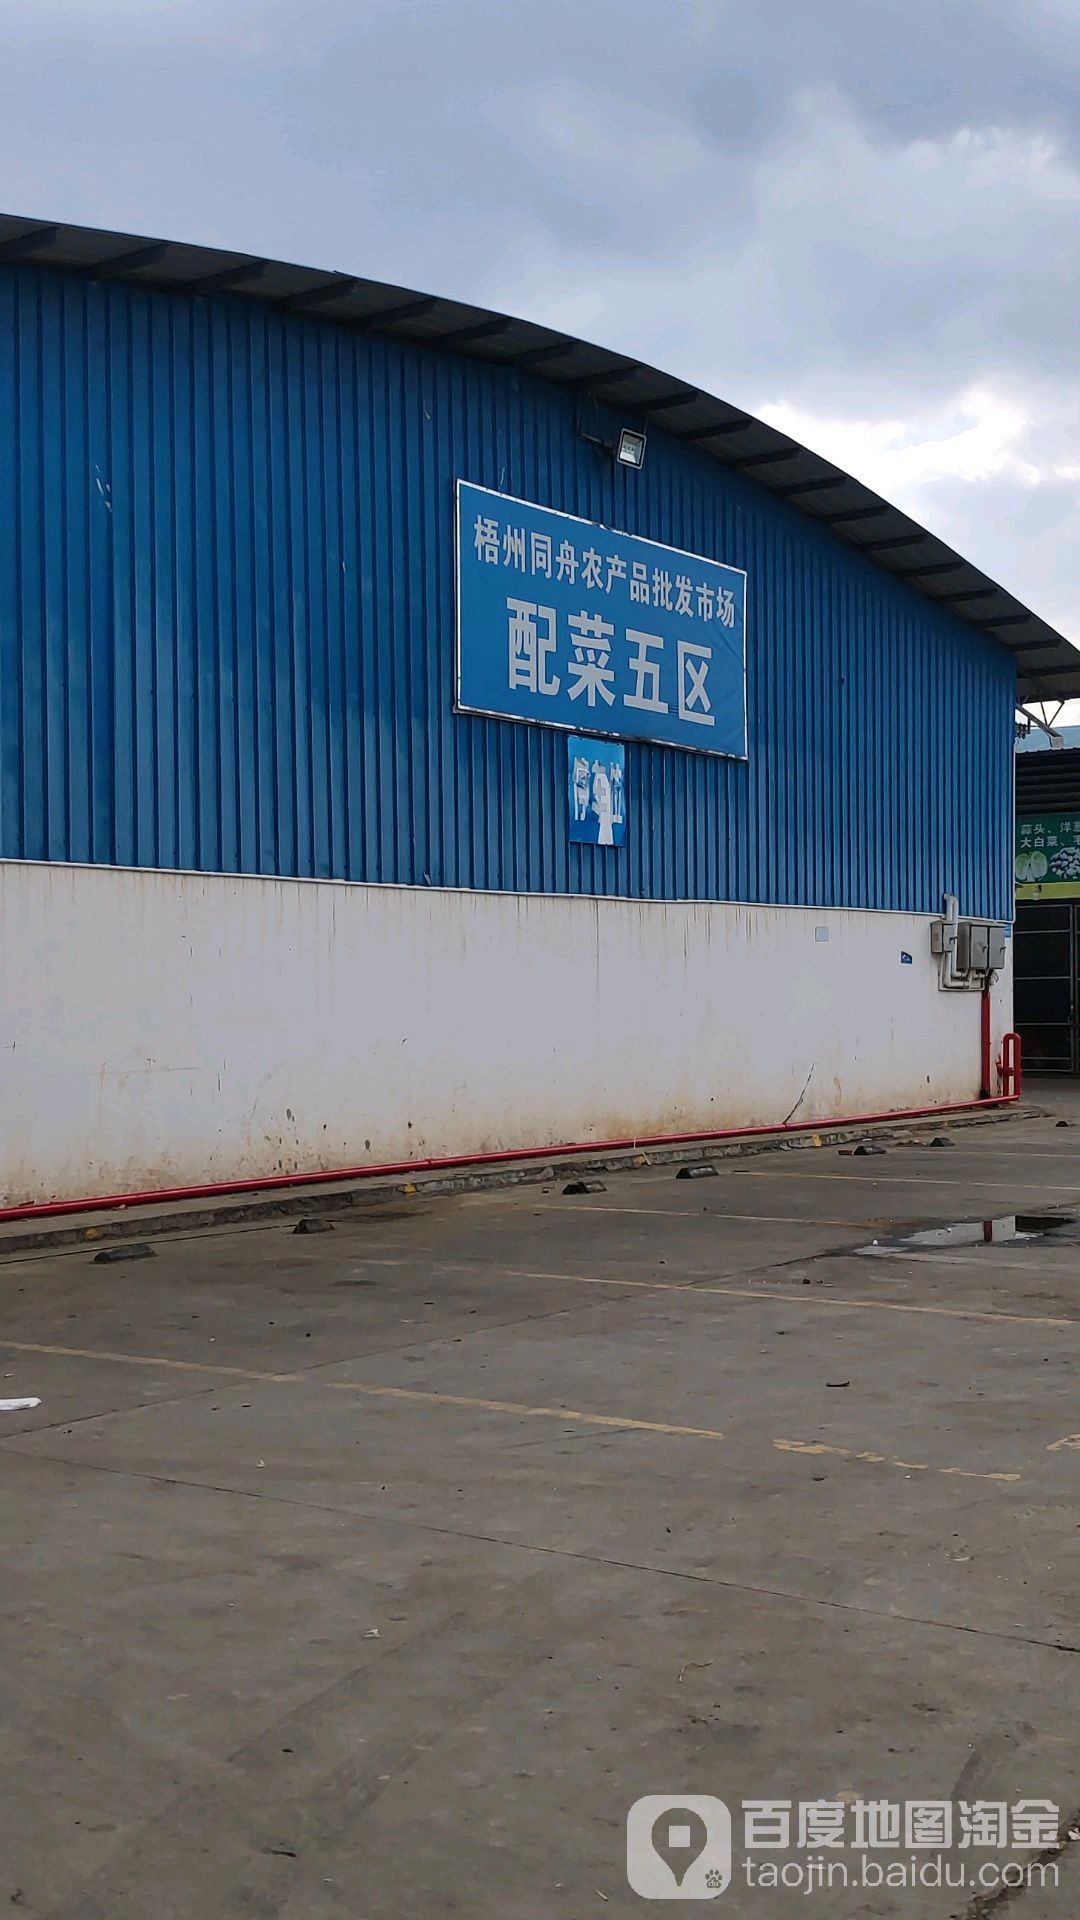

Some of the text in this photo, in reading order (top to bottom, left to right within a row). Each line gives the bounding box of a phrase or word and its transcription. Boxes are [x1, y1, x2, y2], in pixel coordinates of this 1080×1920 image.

[473, 514, 735, 629] 梧州同舟农产品批发市场
[506, 596, 715, 727] 配菜五区
